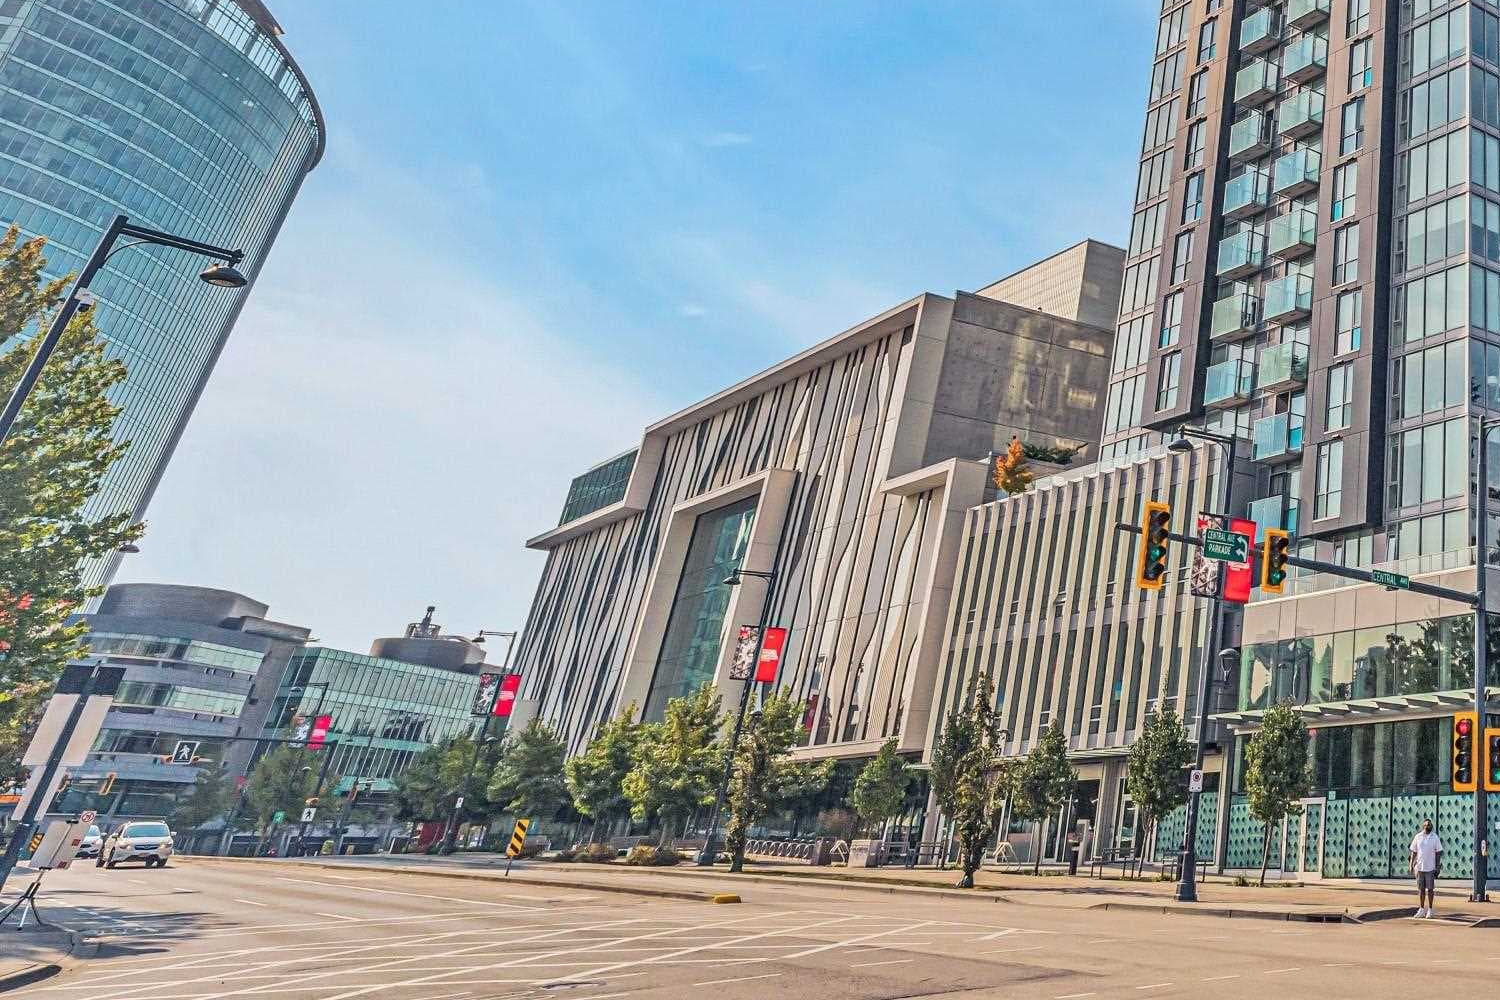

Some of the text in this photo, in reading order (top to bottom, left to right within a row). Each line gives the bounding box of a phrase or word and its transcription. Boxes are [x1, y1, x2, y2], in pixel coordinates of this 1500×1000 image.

[1207, 530, 1226, 541] CENTRAL
[1208, 543, 1232, 555] PARKADE
[1372, 571, 1398, 586] CENTRAL
